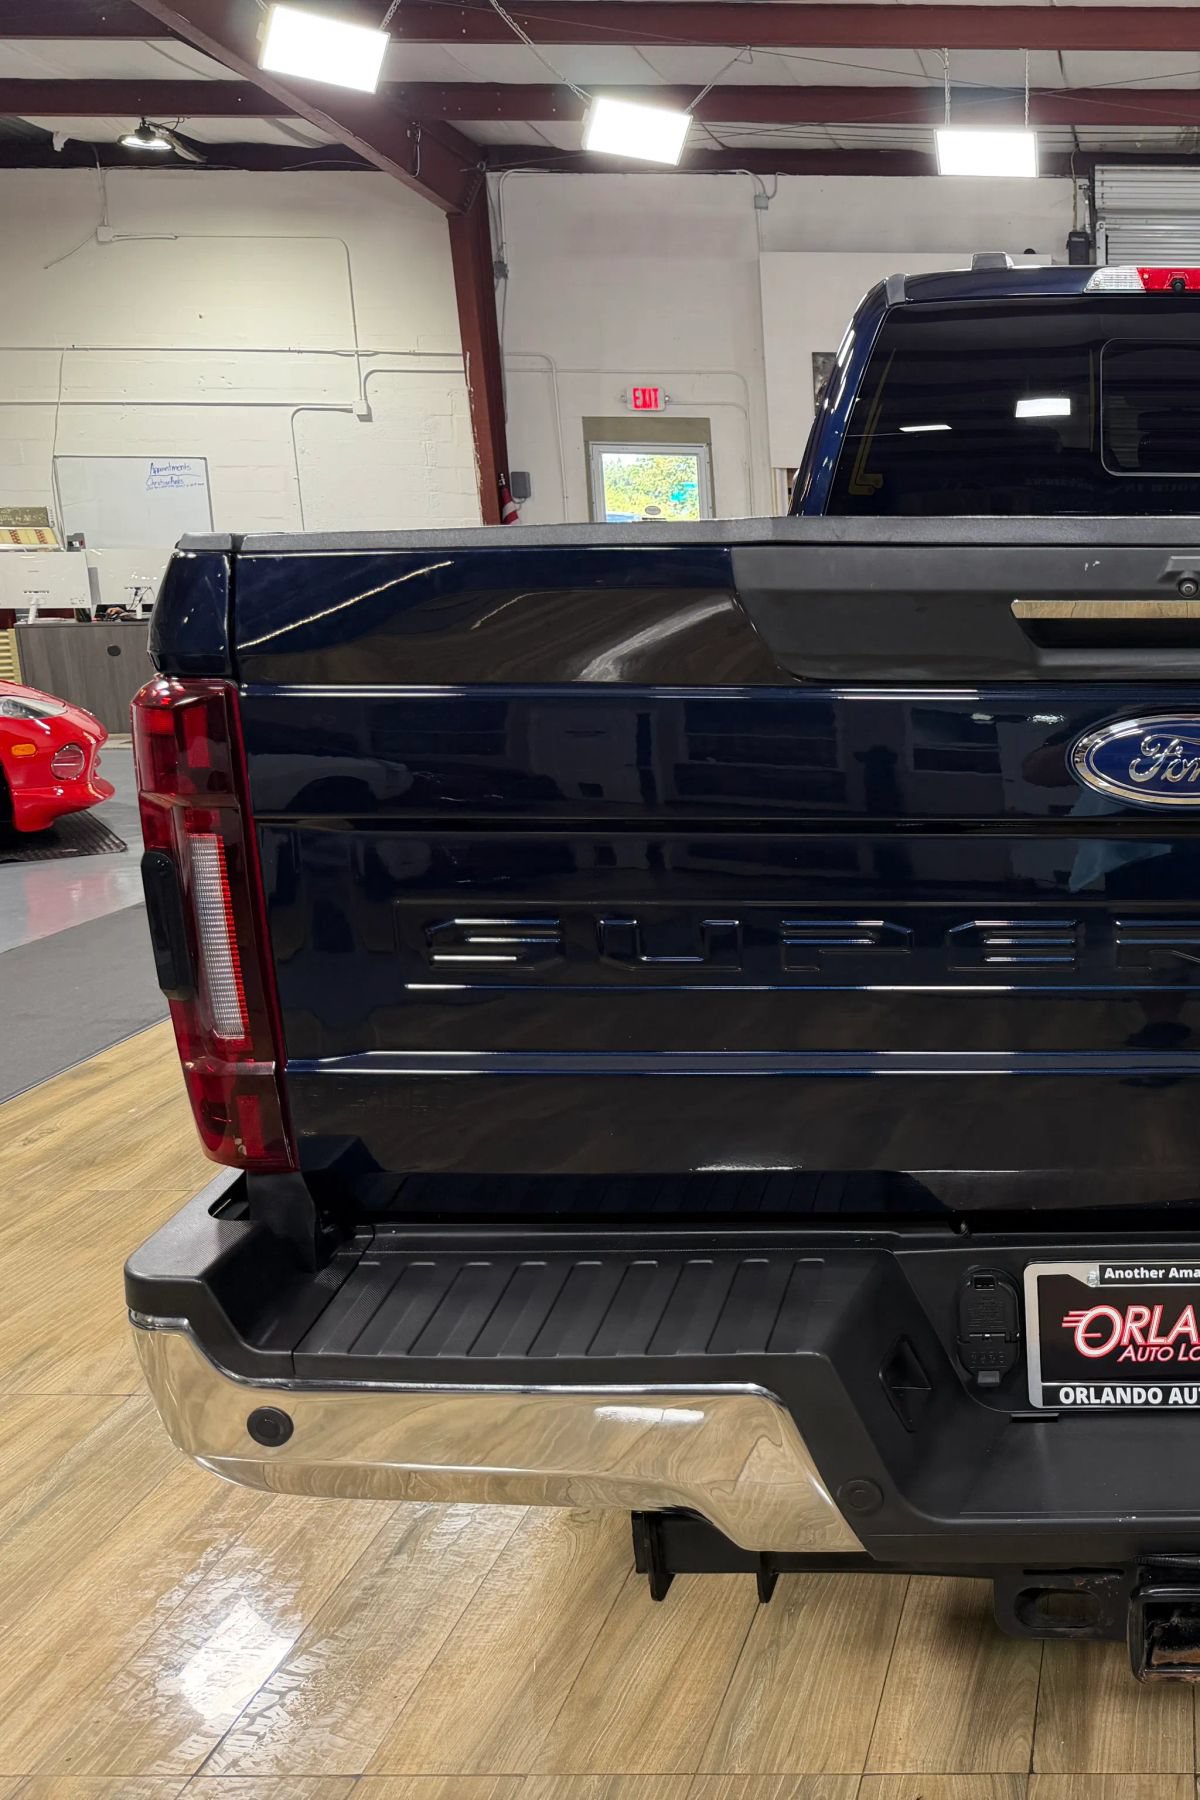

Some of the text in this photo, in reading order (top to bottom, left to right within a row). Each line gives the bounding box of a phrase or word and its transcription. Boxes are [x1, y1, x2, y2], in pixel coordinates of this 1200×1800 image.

[632, 387, 659, 409] EXIT
[1104, 1267, 1165, 1279] Another
[1117, 1346, 1174, 1362] AUTO
[1059, 1386, 1163, 1405] ORLANDO
